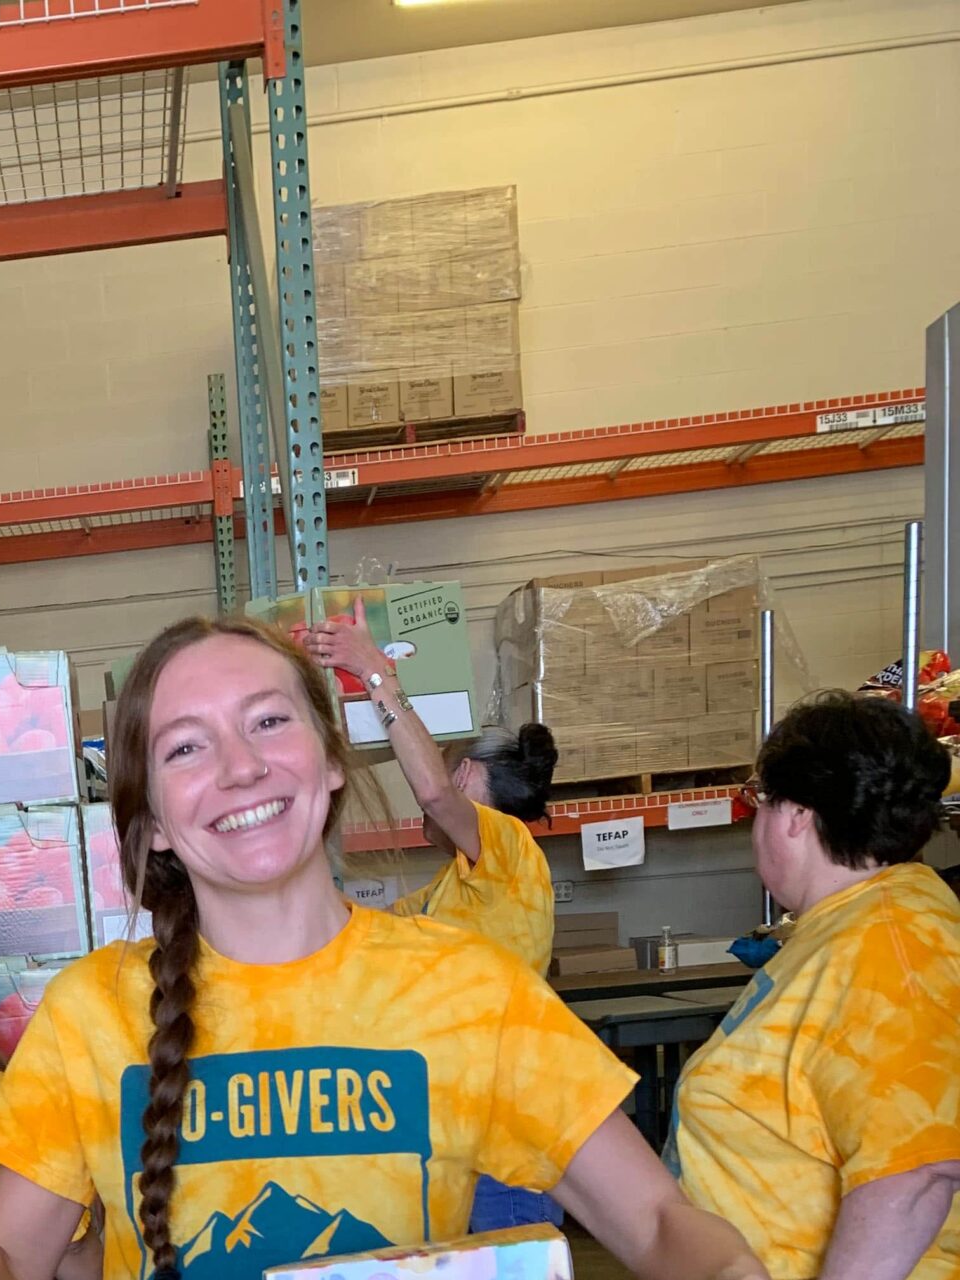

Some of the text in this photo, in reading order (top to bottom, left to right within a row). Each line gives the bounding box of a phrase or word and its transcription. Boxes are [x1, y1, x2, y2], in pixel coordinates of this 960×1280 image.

[882, 403, 919, 417] 15M33
[820, 413, 848, 425] 15J33
[397, 596, 443, 615] CERTIFIED
[403, 608, 443, 626] ORGANIC
[596, 830, 629, 842] TEFAP
[181, 1068, 396, 1142] O-GIVERS
